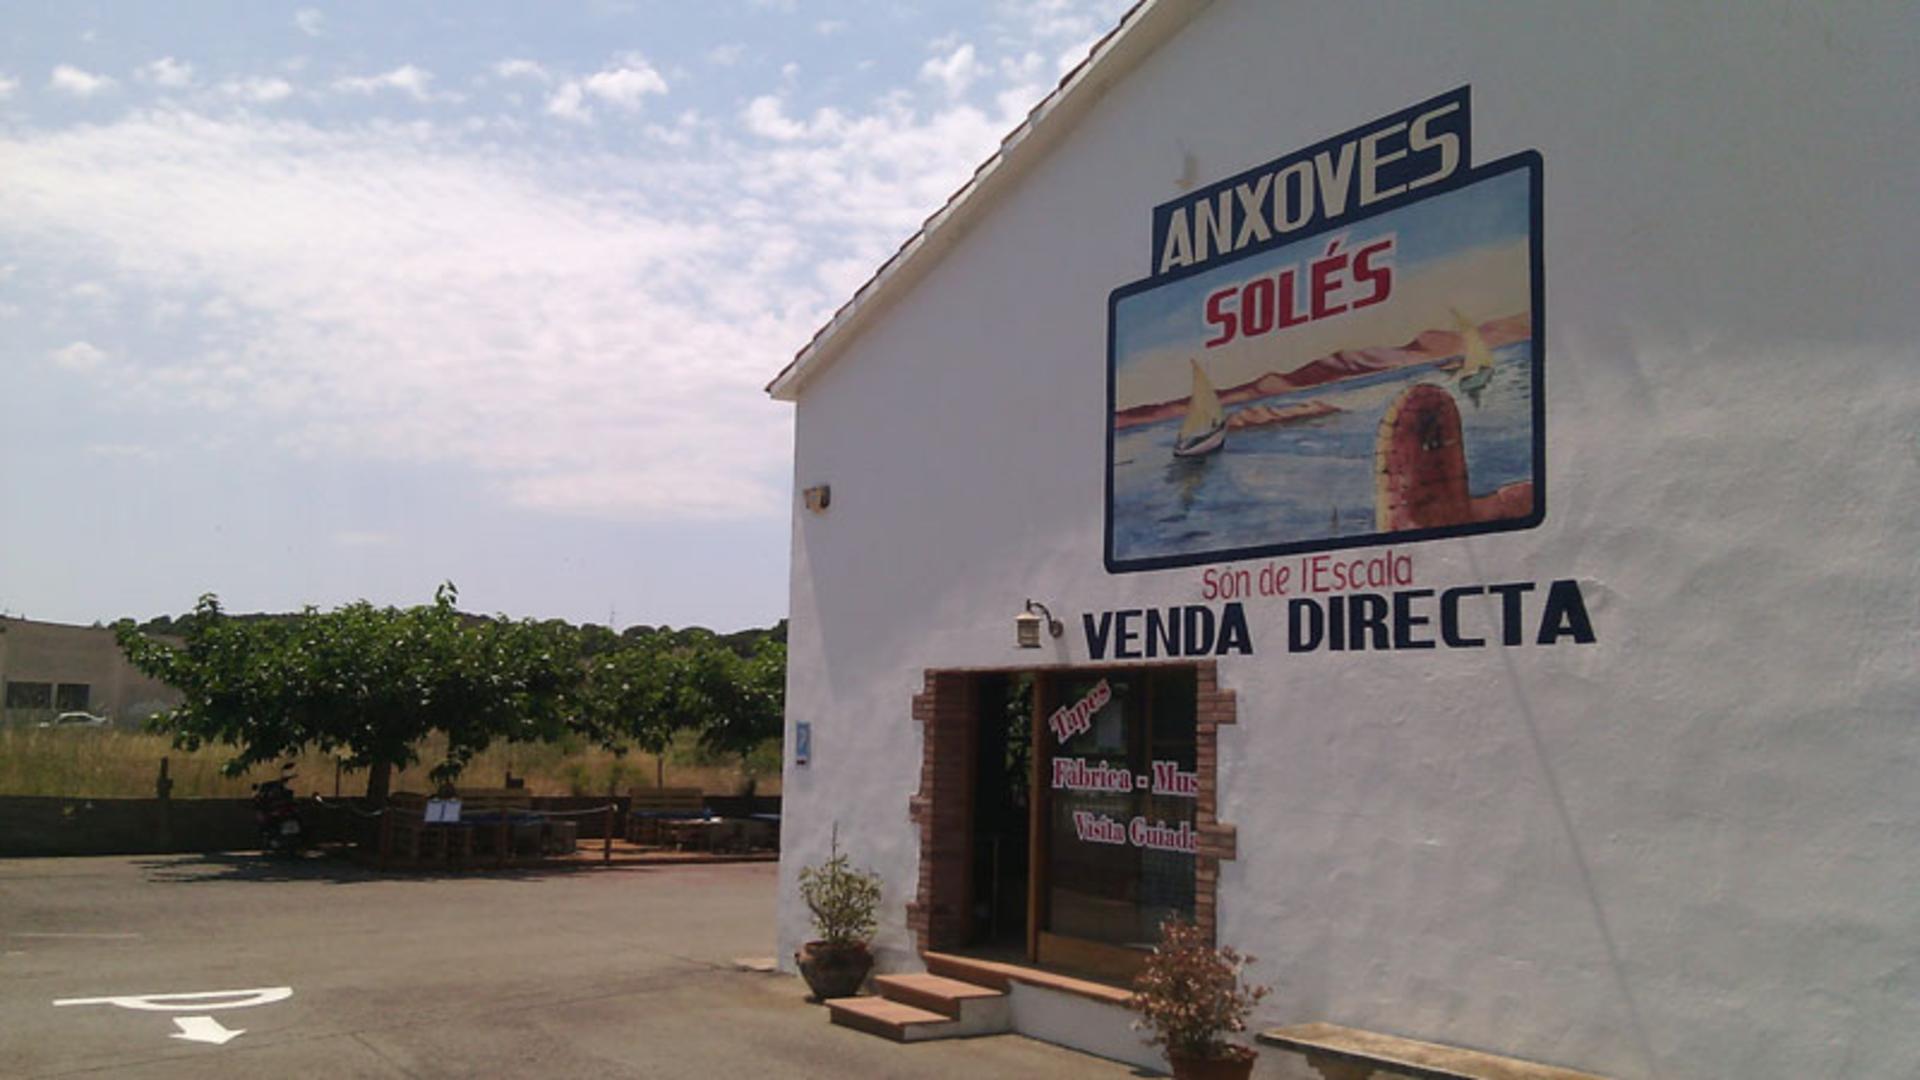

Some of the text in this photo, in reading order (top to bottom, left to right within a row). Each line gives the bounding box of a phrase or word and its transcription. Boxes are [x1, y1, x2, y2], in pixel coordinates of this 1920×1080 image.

[1158, 101, 1462, 274] ANXOVES
[1206, 239, 1393, 348] SOLÉS
[1259, 561, 1290, 596] de
[1083, 579, 1597, 660] VENDA DIRECTA
[1049, 680, 1111, 743] Tapes
[1074, 811, 1126, 844] Visita
